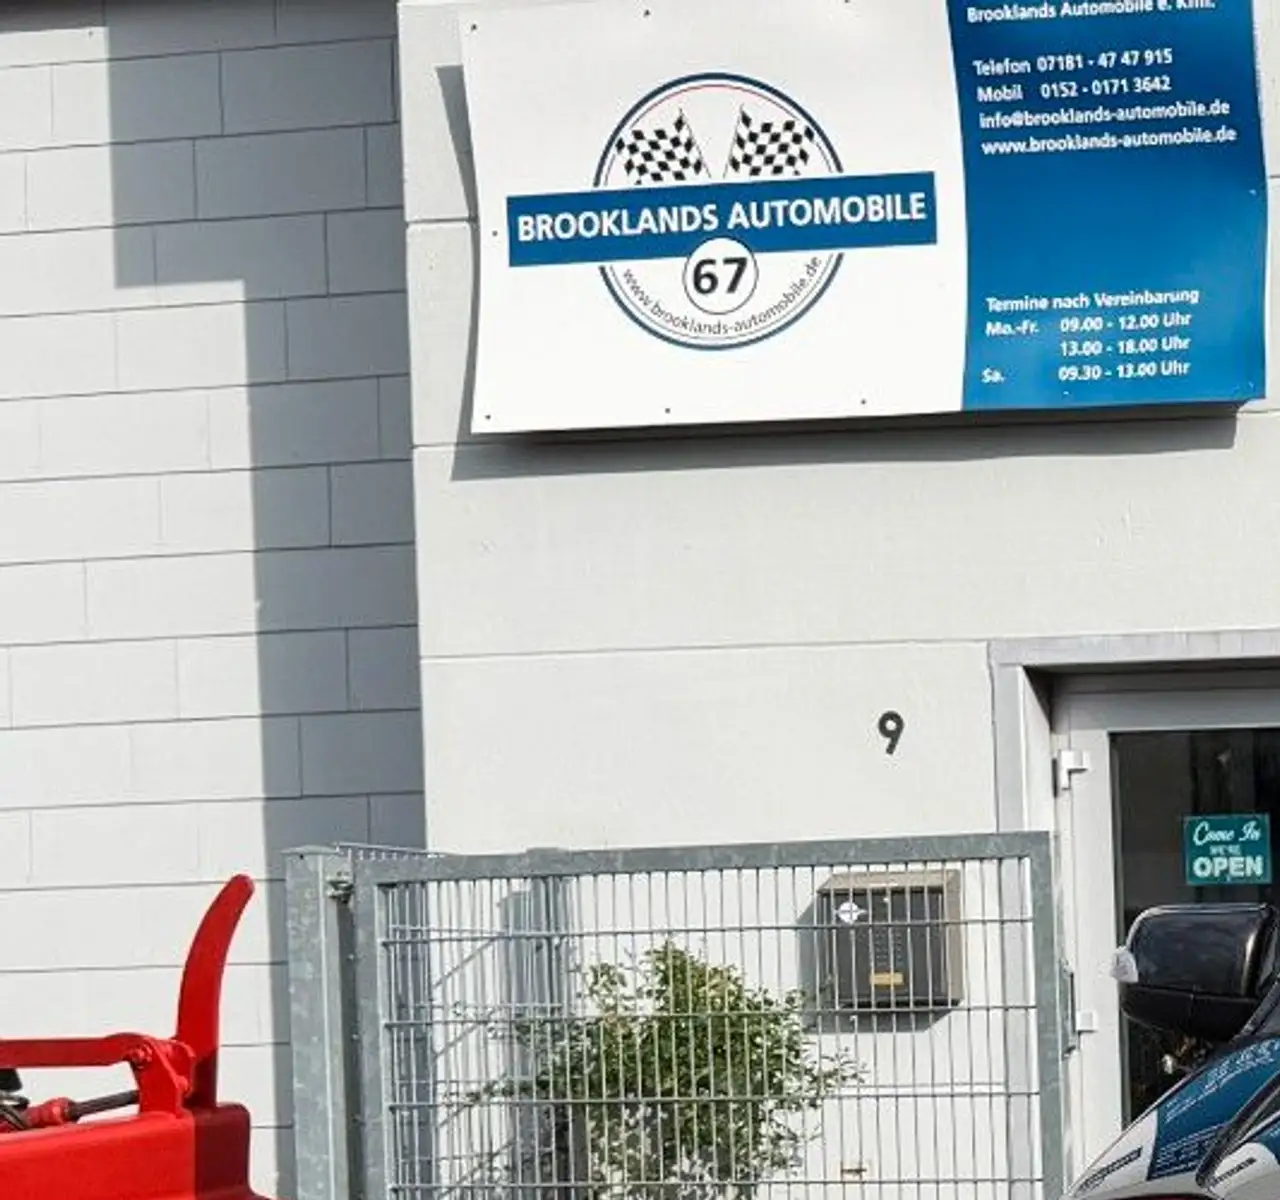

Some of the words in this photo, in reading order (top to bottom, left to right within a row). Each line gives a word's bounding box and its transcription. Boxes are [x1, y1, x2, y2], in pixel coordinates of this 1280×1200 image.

[966, 1, 1057, 23] Brooklands
[1060, 0, 1153, 17] Automobile
[972, 58, 1031, 76] Telefon
[1037, 54, 1083, 72] 07181
[1097, 52, 1116, 69] 47
[1121, 50, 1139, 67] 47
[1144, 48, 1172, 66] 915
[977, 84, 1023, 102] Mobil
[1040, 82, 1078, 99] 0152
[1092, 79, 1128, 96] 0171
[1133, 75, 1172, 92] 3642
[979, 100, 1230, 129] info@brooklands-automobile.de
[981, 125, 1238, 155] www.brooklands-automobile.de
[516, 201, 719, 242] BROOKLANDS
[727, 192, 926, 229] AUTOMOBILE
[692, 256, 748, 295] 67
[623, 256, 822, 335] www.brooklands-automobile.de
[986, 296, 1049, 313] Termine
[1053, 292, 1089, 310] nach
[1095, 289, 1200, 307] Vereinbarung
[985, 320, 1039, 337] Mo.-Fr.
[1060, 316, 1103, 333] 09.00
[1119, 314, 1158, 330] 12.00
[1162, 312, 1192, 328] Uhr
[1061, 340, 1102, 357] 13.00
[1118, 338, 1156, 354] 18.00
[1161, 336, 1191, 352] Uhr
[981, 367, 1005, 384] Sa.
[1058, 364, 1100, 381] 09.30
[1116, 362, 1156, 379] 13.00
[1160, 360, 1190, 376] Uhr
[878, 710, 905, 755] 9
[1193, 820, 1235, 846] Come
[1238, 820, 1261, 841] In
[1193, 854, 1264, 878] OPEN
